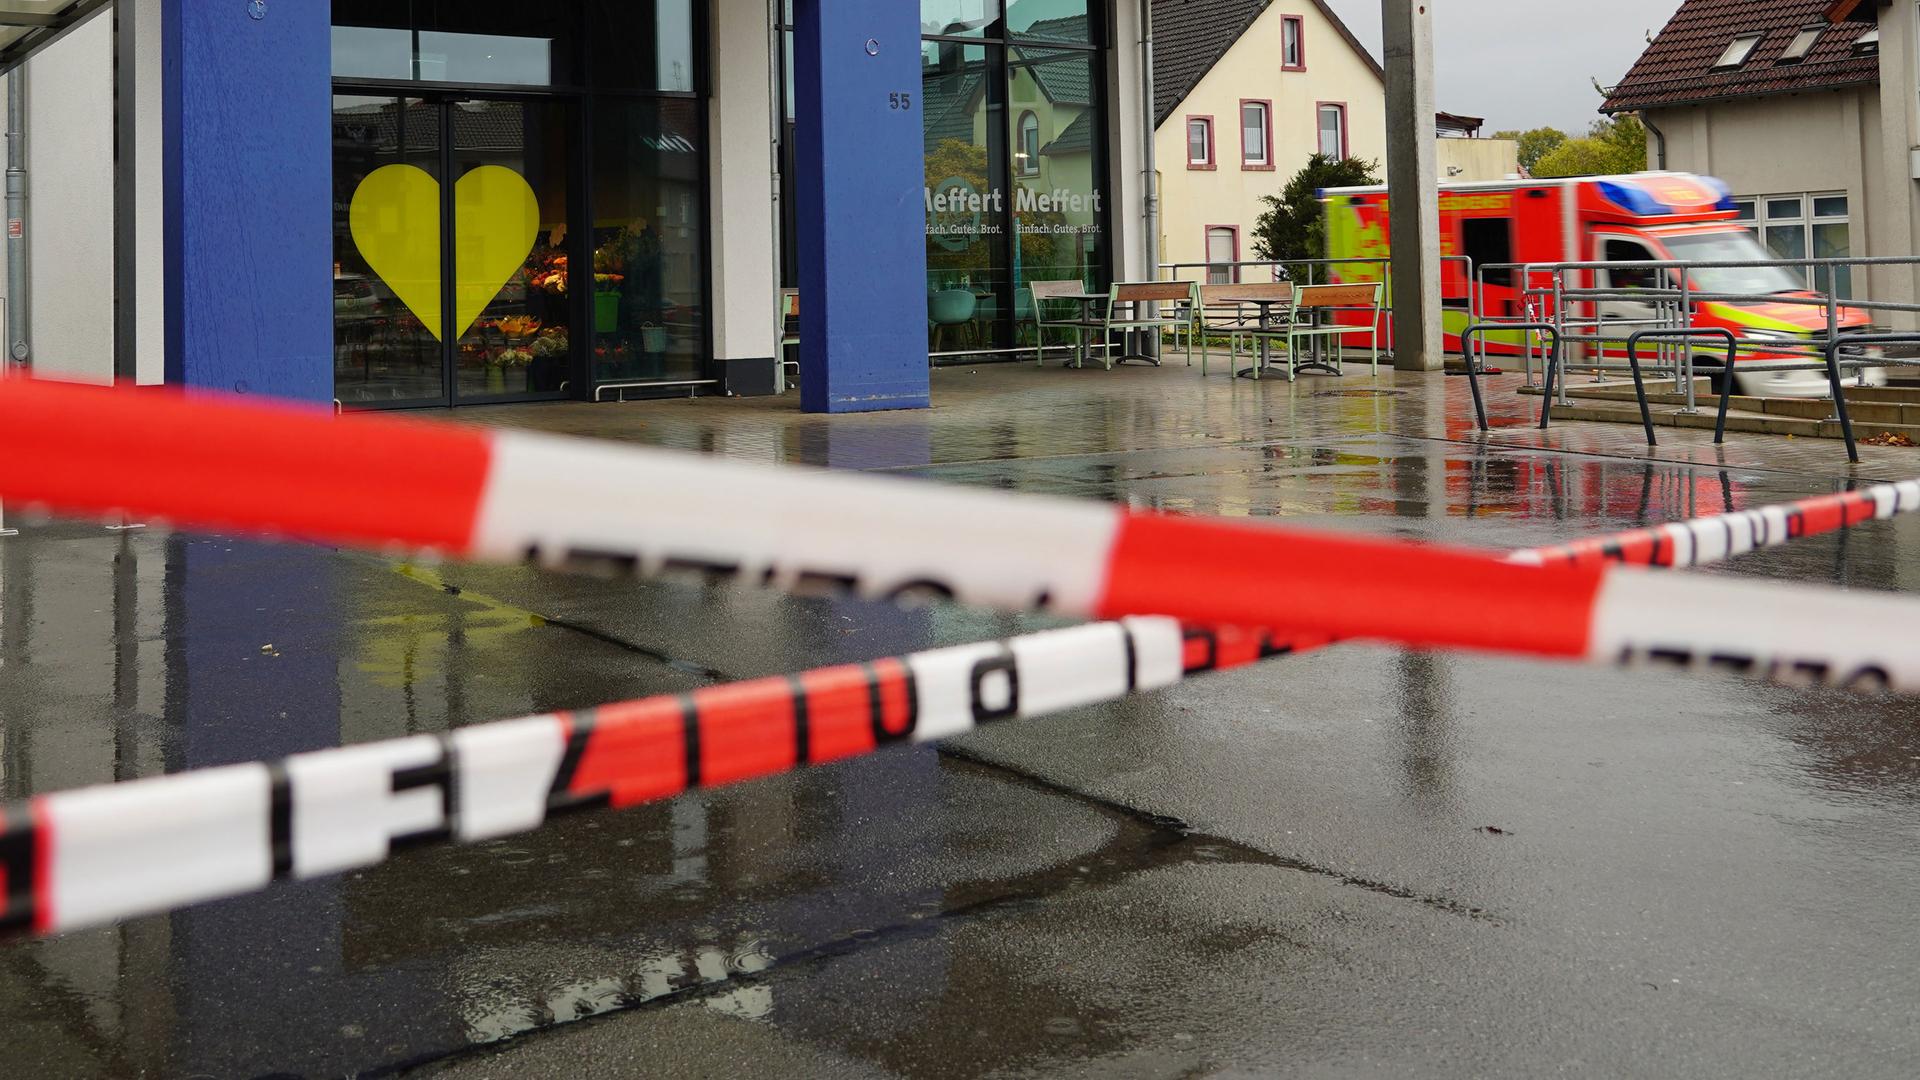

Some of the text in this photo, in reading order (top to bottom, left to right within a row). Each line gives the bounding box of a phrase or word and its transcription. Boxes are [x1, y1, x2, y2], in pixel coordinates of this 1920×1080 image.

[889, 92, 910, 110] 55
[1015, 188, 1102, 212] Meffert
[926, 224, 1003, 235] fach. Gutes. Brot.
[1016, 224, 1103, 234] Einfach. Gutes. Brot.
